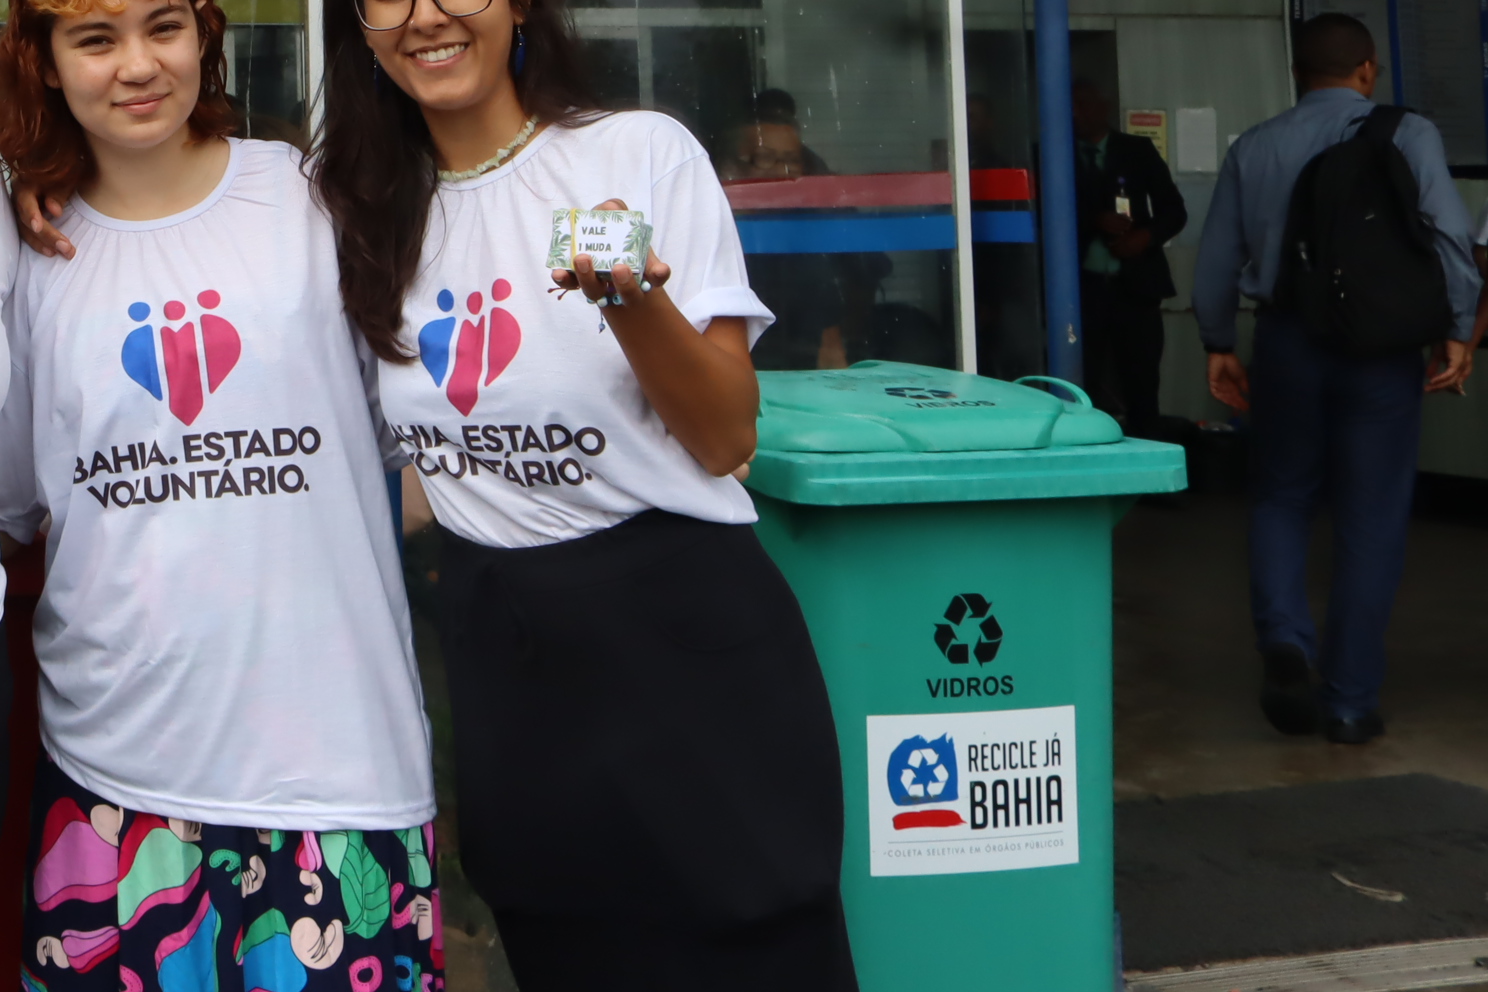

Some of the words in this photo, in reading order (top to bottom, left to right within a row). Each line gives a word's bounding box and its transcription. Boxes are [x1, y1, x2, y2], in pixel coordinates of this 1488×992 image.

[581, 226, 606, 236] VALE
[585, 243, 612, 252] MUDA
[182, 426, 321, 463] ESTADO
[461, 424, 606, 456] ESTADO
[87, 459, 310, 508] VOLUNTÁRIO.
[926, 675, 1014, 698] VIDROS
[968, 740, 1037, 772] RECICLE
[1043, 733, 1061, 768] JÁ
[969, 775, 1063, 830] BAHIA
[887, 847, 922, 858] COLETA
[927, 845, 966, 856] SELETIVA
[969, 845, 981, 854] EM
[1024, 839, 1065, 850] PÚBLICOS
